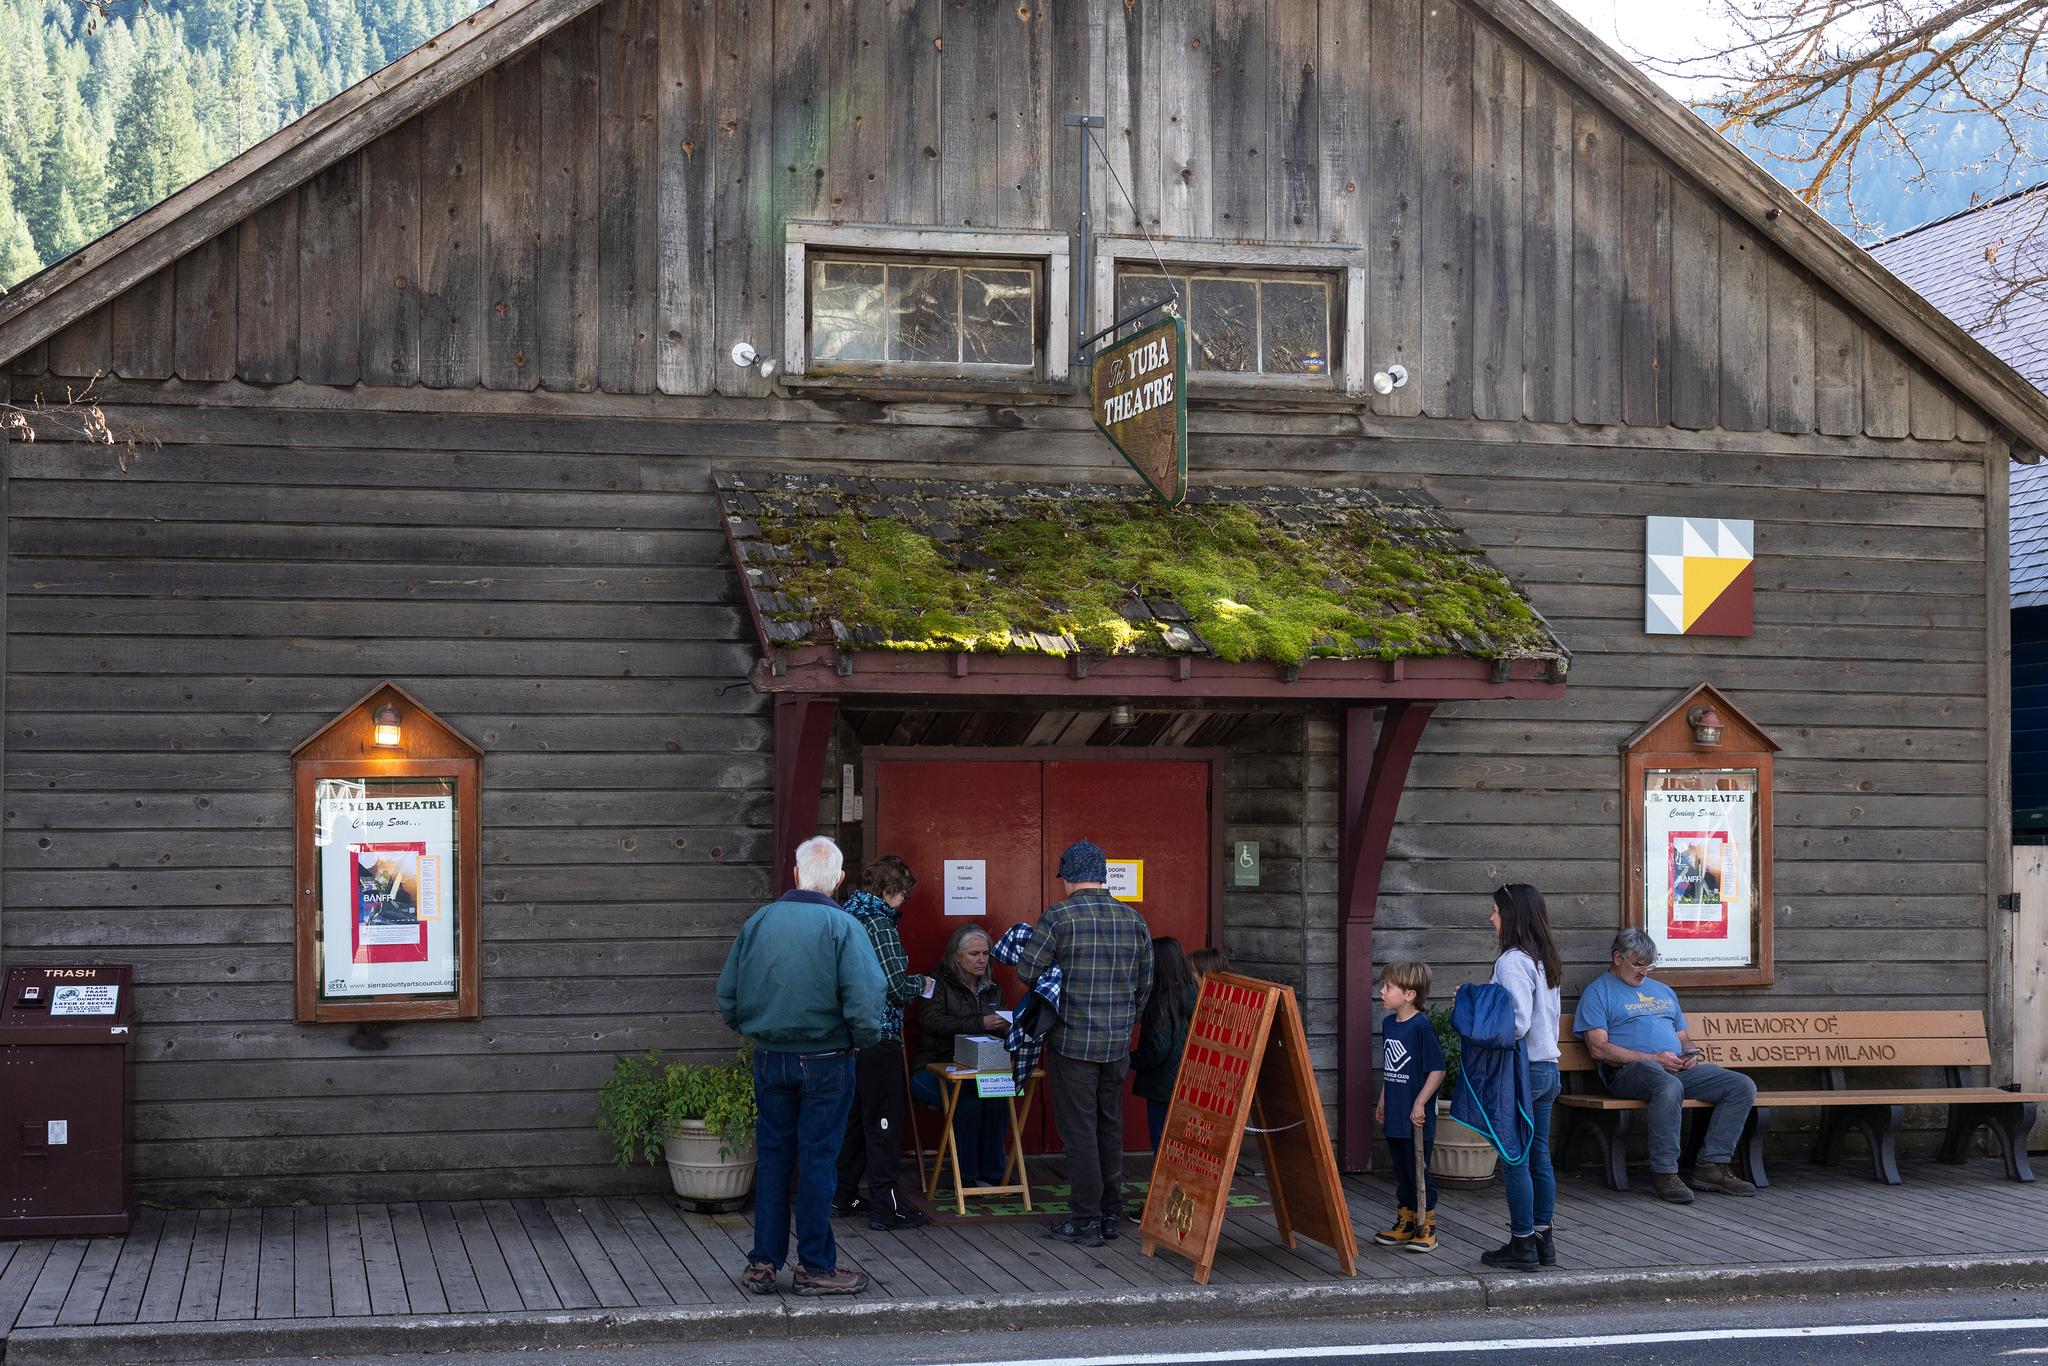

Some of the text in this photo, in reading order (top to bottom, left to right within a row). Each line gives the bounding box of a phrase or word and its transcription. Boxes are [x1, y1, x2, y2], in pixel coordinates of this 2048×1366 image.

[1108, 336, 1170, 389] The YUBA
[1104, 371, 1175, 427] THEATRE
[387, 800, 446, 810] THEATRE
[1667, 794, 1695, 803] YUBA
[1697, 794, 1745, 803] THEATRE
[1669, 808, 1695, 819] Coming
[363, 894, 392, 902] BANFF
[1194, 981, 1266, 1050] SHOW
[1703, 1015, 1839, 1036] IN MEMORY OF
[1729, 1046, 1742, 1062] &
[1747, 1045, 1821, 1062] JOSEPH
[1826, 1043, 1896, 1062] MILANO
[1178, 1043, 1249, 1117] TODAY
